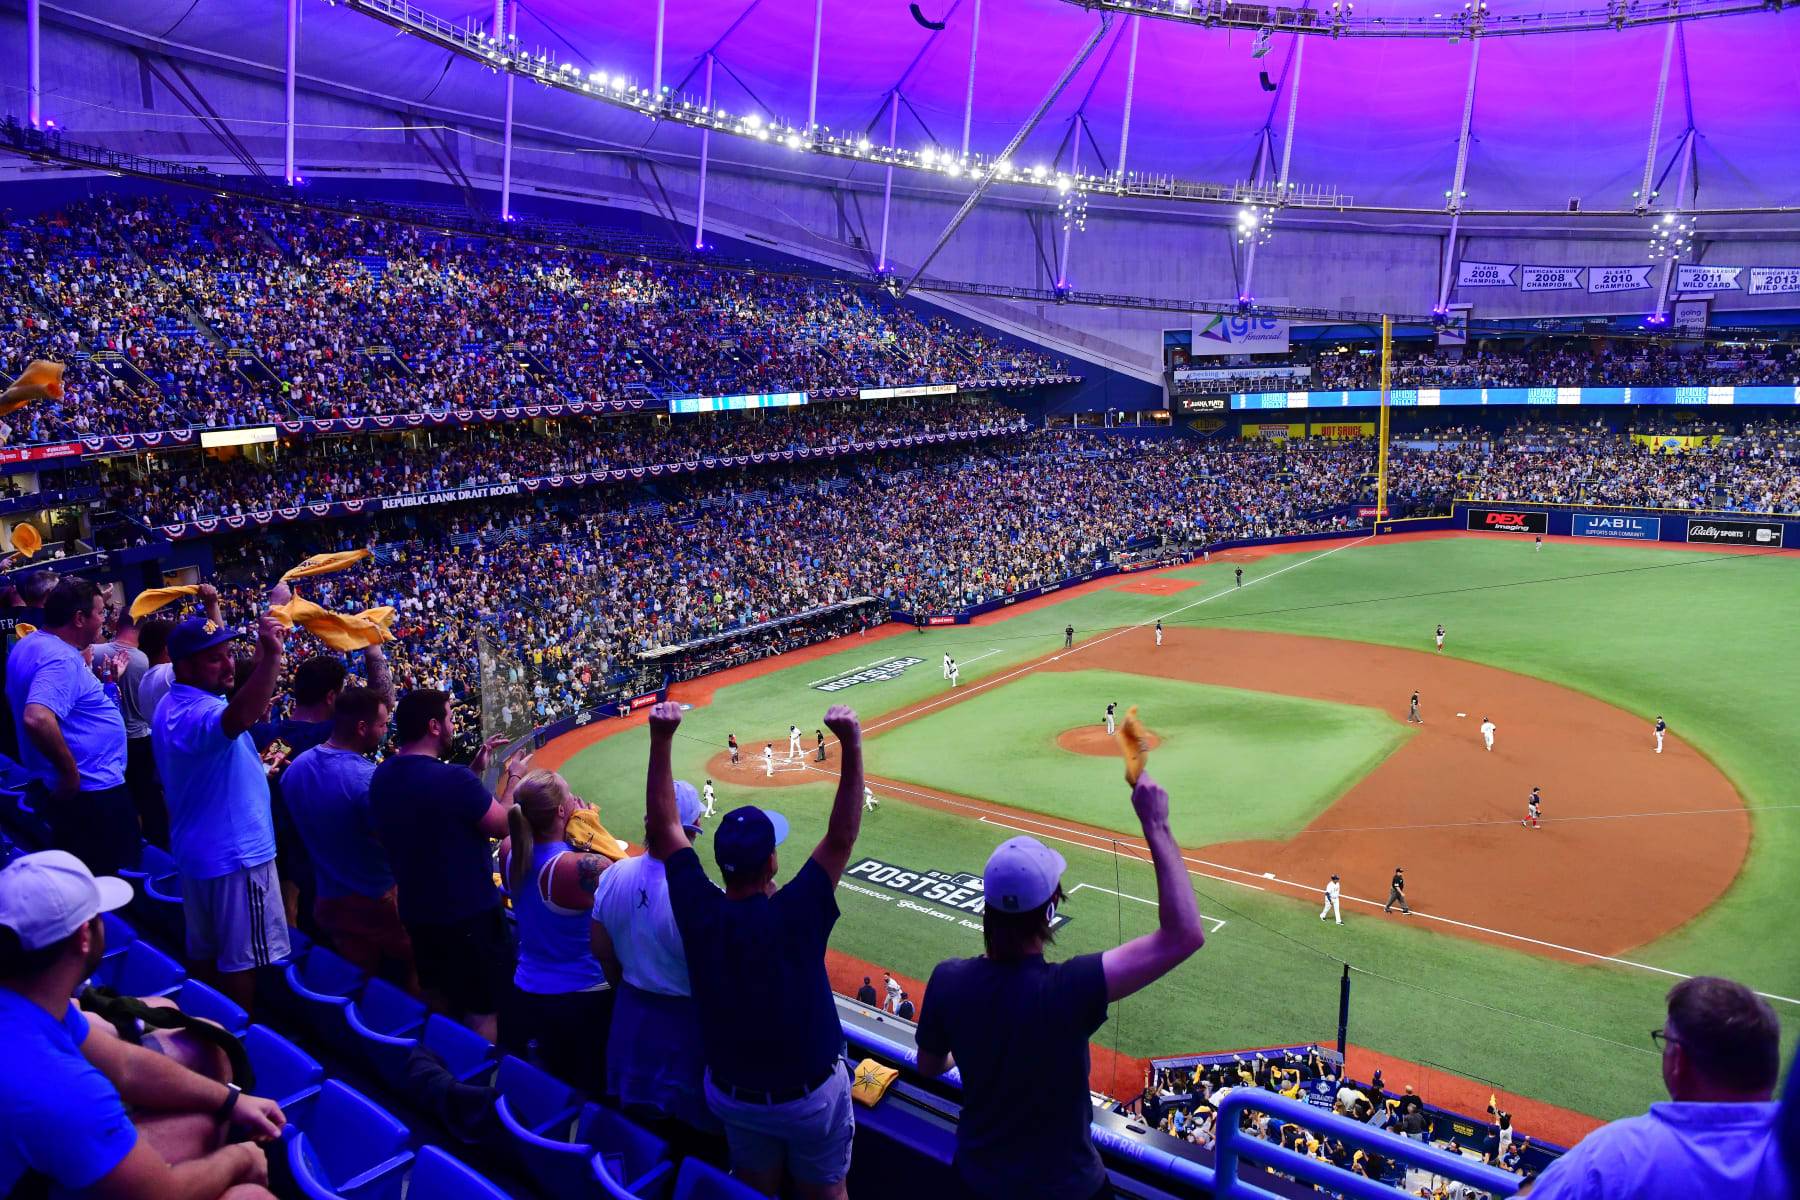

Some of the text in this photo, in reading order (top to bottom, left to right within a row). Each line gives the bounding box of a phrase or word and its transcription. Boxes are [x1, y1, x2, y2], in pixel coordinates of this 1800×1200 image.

[1471, 270, 1499, 279] 2008
[1535, 274, 1565, 282] 2008
[1602, 274, 1633, 284] 2010
[1693, 273, 1722, 282] 2011
[1765, 275, 1798, 284] 2013
[1463, 277, 1506, 285] CHAMPIONS
[1680, 309, 1702, 317] going
[1676, 316, 1705, 324] beyond
[1239, 329, 1283, 345] financial
[1321, 425, 1362, 437] HOT SAUCE
[382, 484, 519, 510] REPUBLIC BANK DRAFT ROOM
[1485, 512, 1527, 526] DEX
[1588, 517, 1643, 529] JABIL
[1690, 525, 1744, 540] Bally SPORTS
[1120, 1138, 1145, 1160] RAIL
